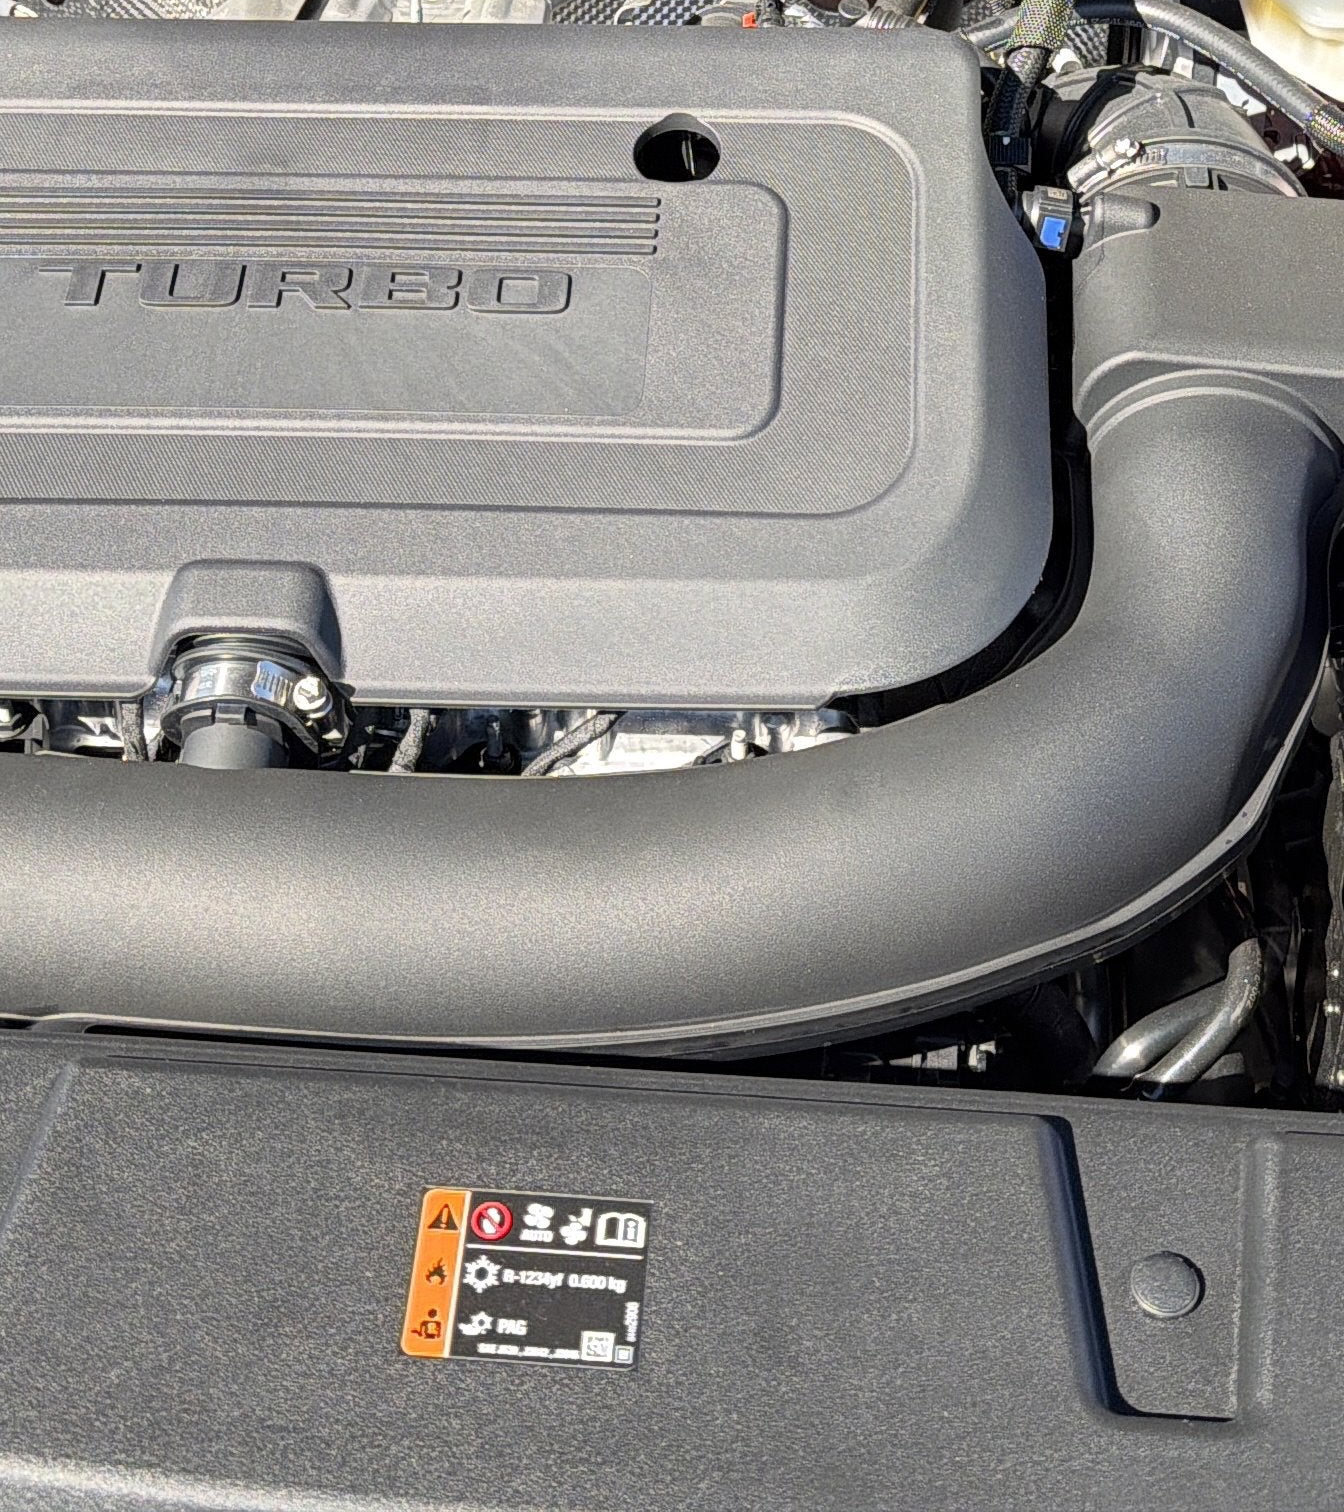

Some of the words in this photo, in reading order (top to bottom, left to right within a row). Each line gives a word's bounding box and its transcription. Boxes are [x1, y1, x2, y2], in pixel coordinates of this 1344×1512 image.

[38, 263, 574, 316] TURBO
[519, 1229, 554, 1243] AUTO
[607, 1276, 628, 1294] kg
[496, 1318, 528, 1336] PAG
